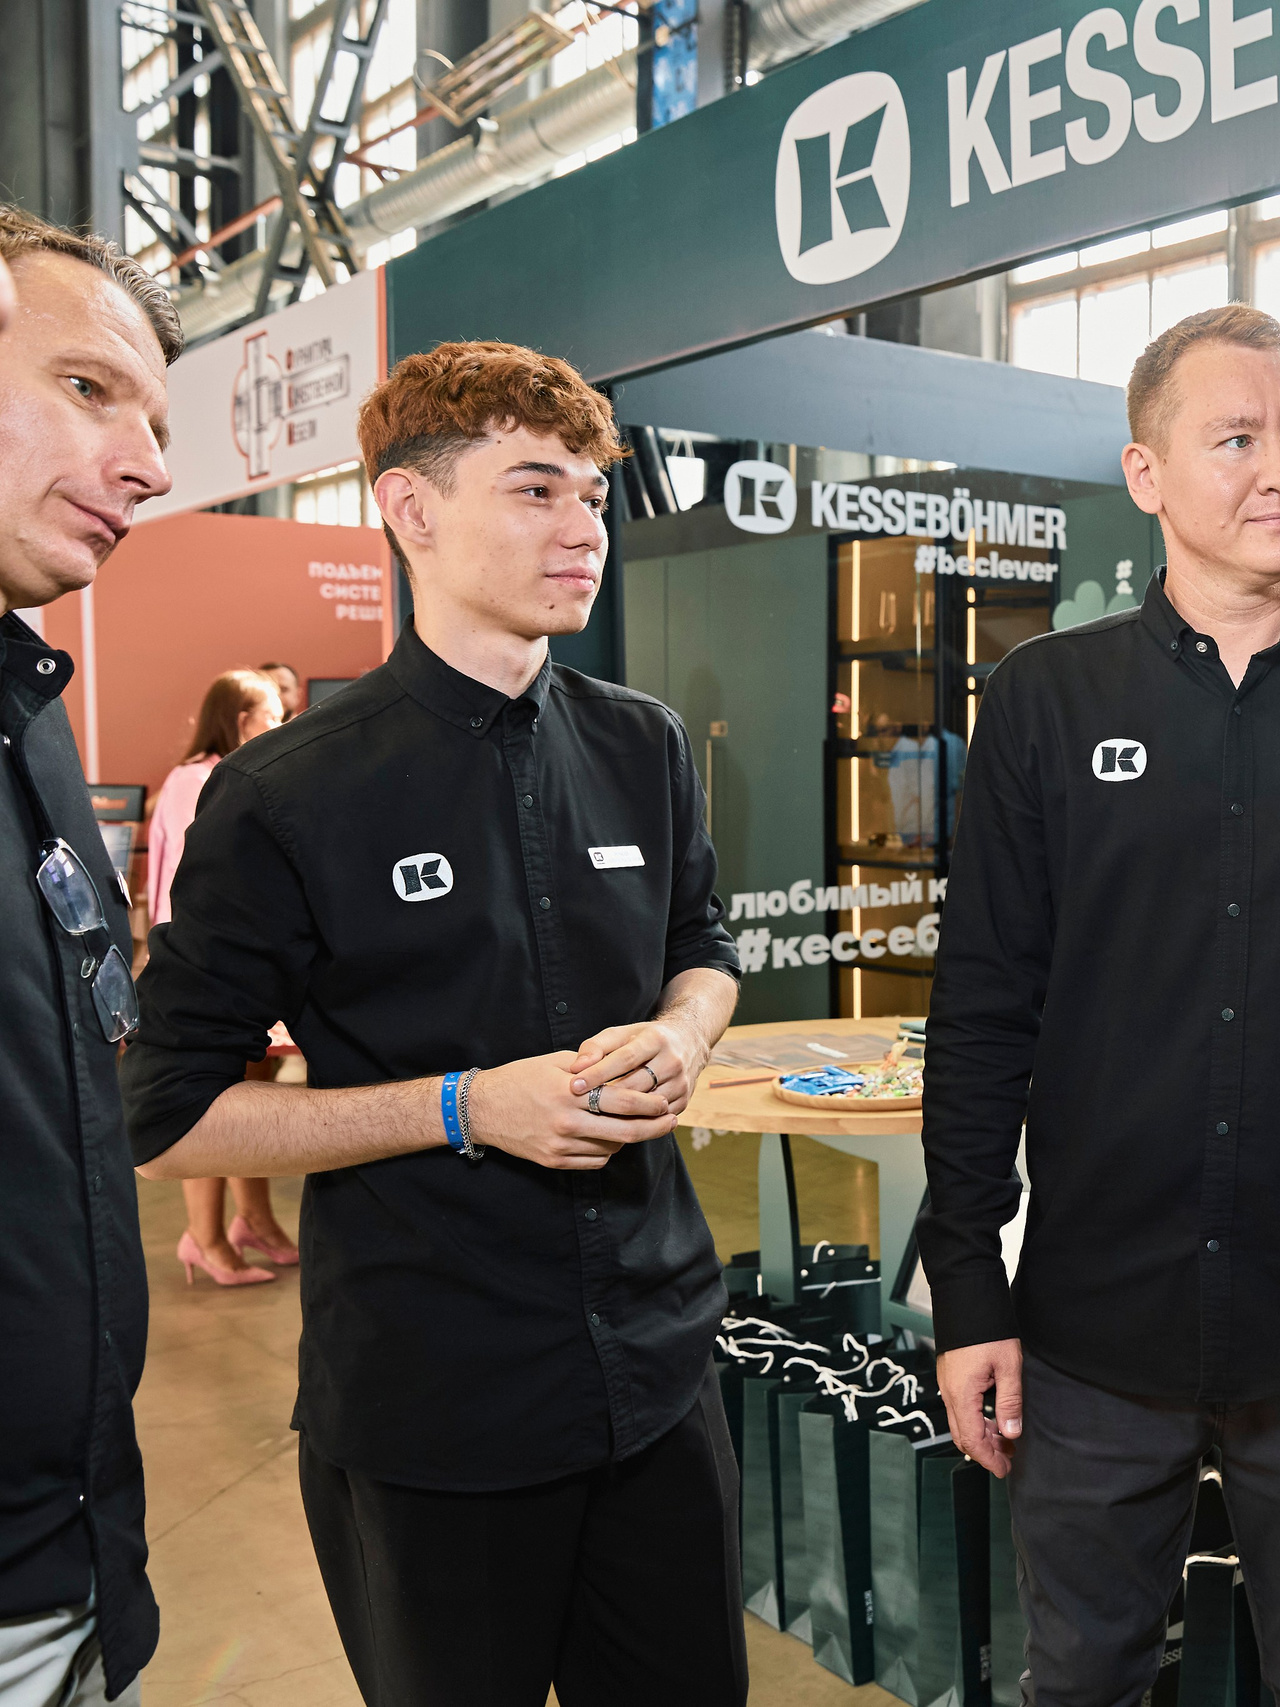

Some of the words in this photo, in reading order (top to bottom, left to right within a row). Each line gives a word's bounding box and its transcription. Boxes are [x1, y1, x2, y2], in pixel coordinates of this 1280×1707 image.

[811, 480, 1067, 550] KESSEBÖHMER
[914, 544, 1059, 582] #beclever
[729, 872, 923, 921] любимый
